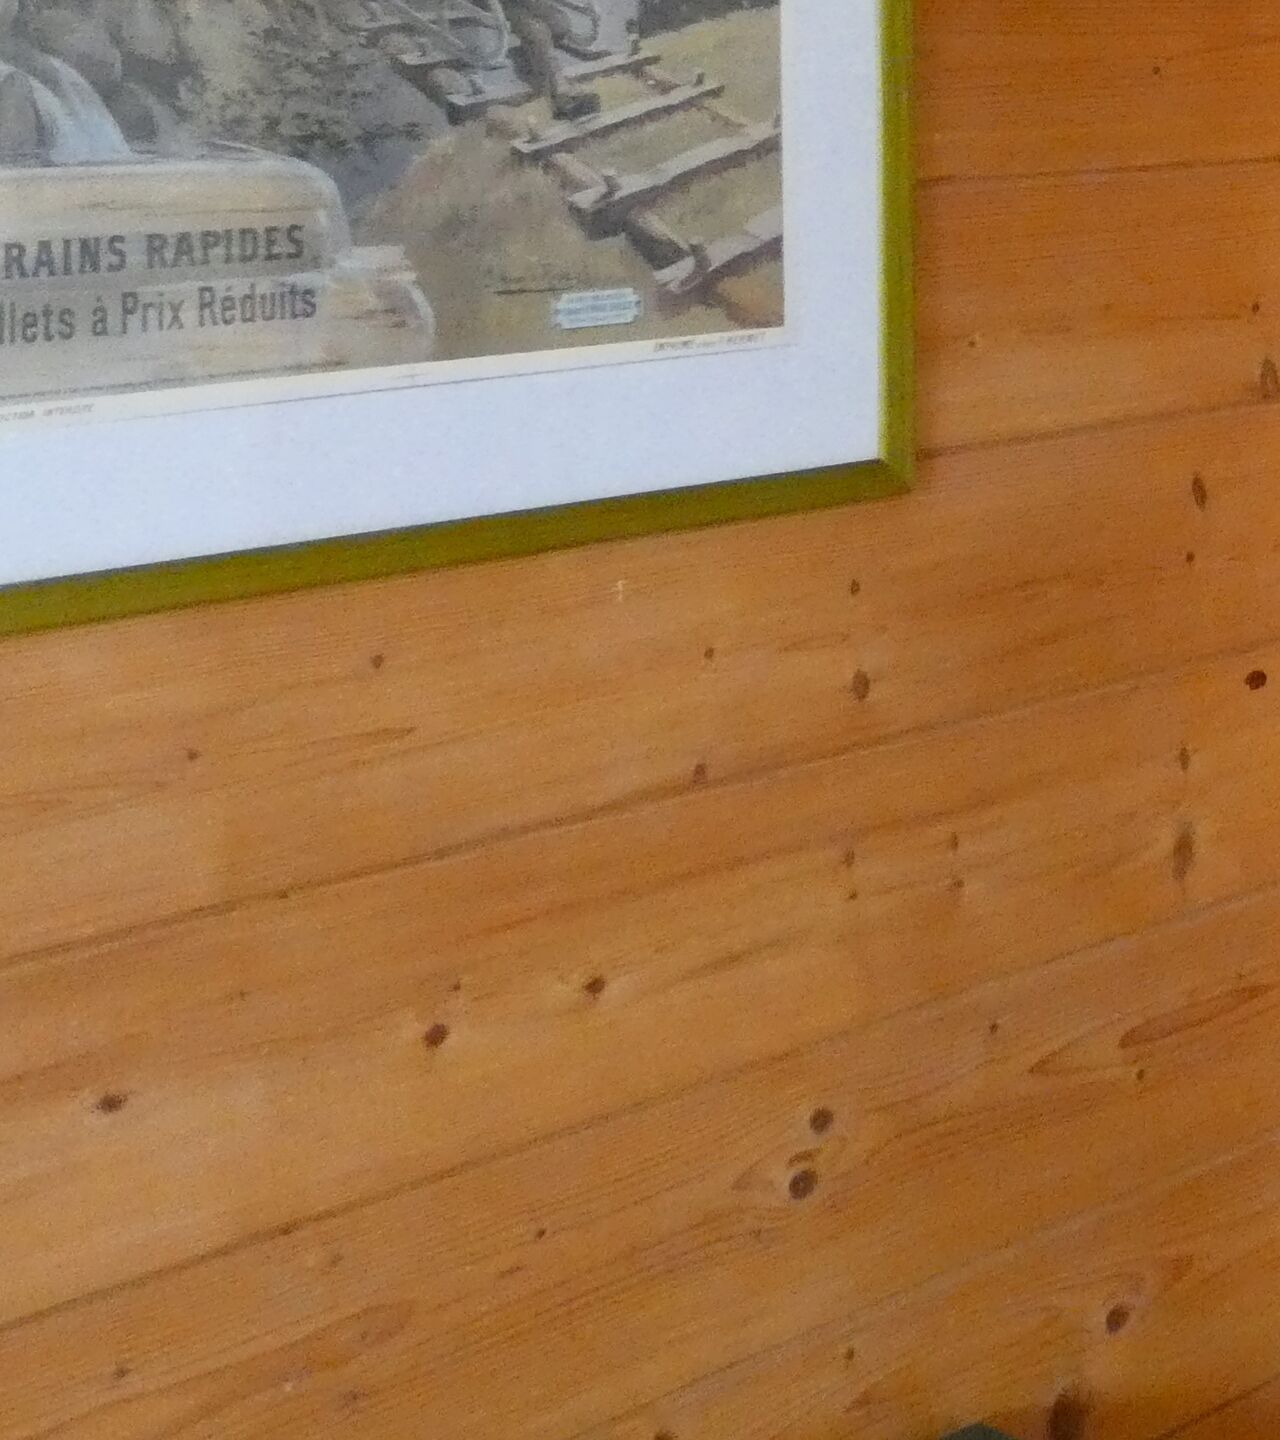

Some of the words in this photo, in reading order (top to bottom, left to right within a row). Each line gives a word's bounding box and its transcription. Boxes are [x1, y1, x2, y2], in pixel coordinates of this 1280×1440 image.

[145, 224, 304, 270] RAPIDES
[91, 295, 108, 337] à
[121, 291, 185, 334] Prix
[198, 281, 316, 328] Réduits
